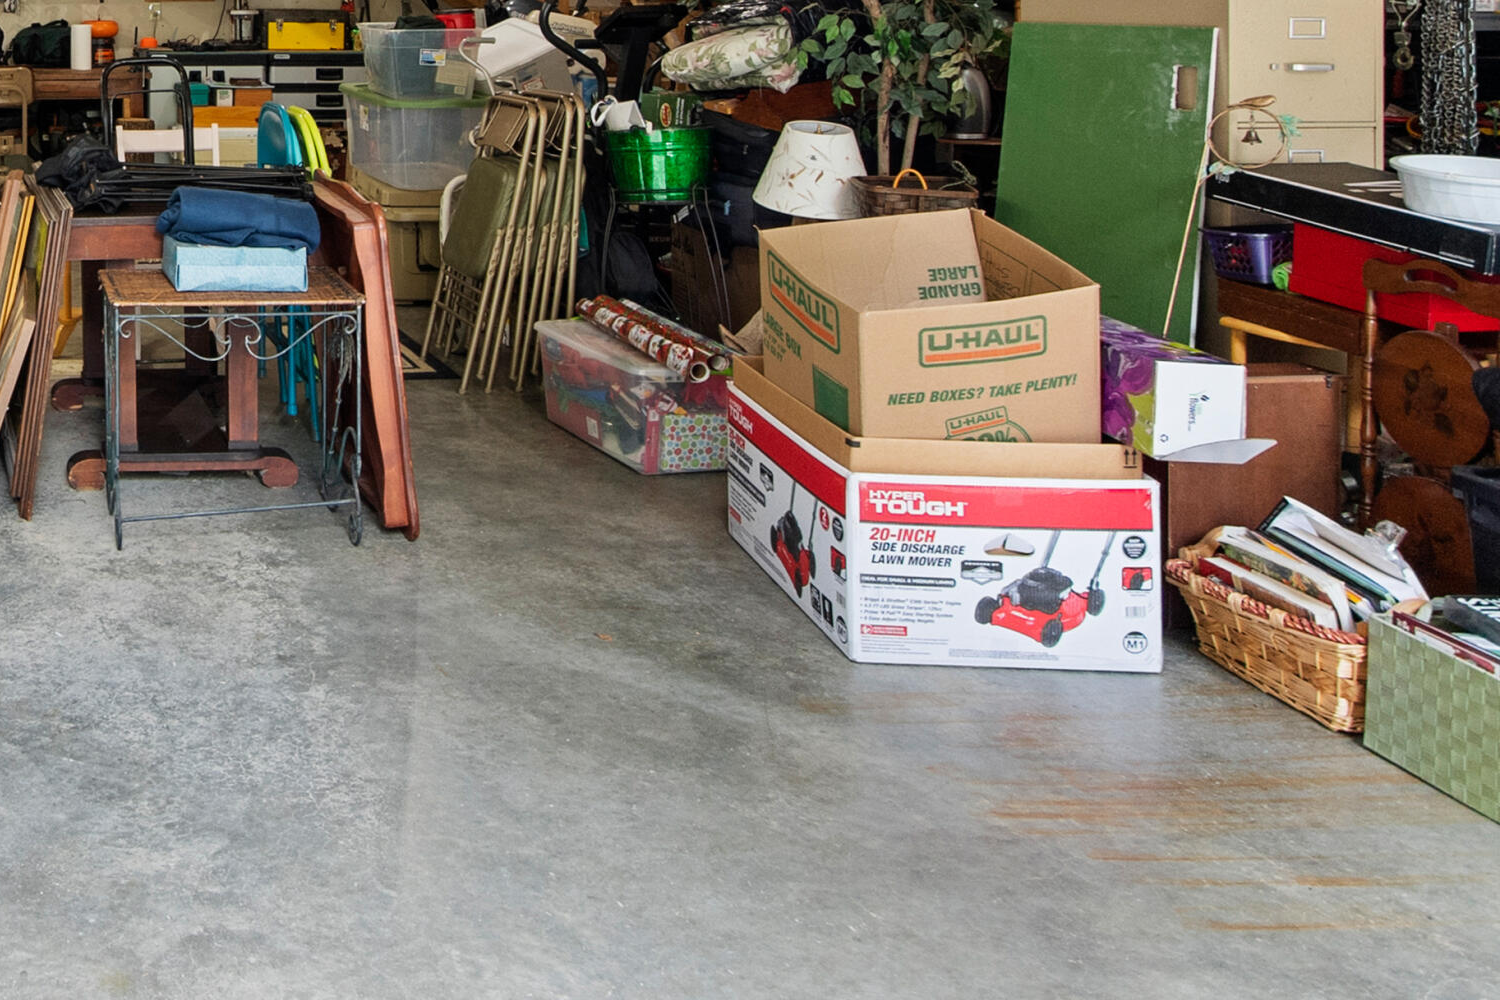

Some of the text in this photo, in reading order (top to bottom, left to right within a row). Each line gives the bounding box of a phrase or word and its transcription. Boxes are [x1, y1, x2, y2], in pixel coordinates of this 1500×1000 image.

[927, 265, 979, 281] LARGE
[771, 260, 834, 331] U-HAUL
[917, 281, 982, 300] GRANDE
[928, 323, 1041, 351] U-HAUL
[887, 373, 1078, 406] NEED BOXES? TAKE PLENTY!
[949, 410, 1005, 429] U-HAUL
[868, 490, 925, 501] HYPER
[869, 500, 965, 517] TOUGH
[869, 527, 936, 543] 20-INCH
[871, 541, 966, 556] SIDE DISCHARGE
[871, 554, 905, 565] LAWN
[908, 556, 953, 567] MOWER
